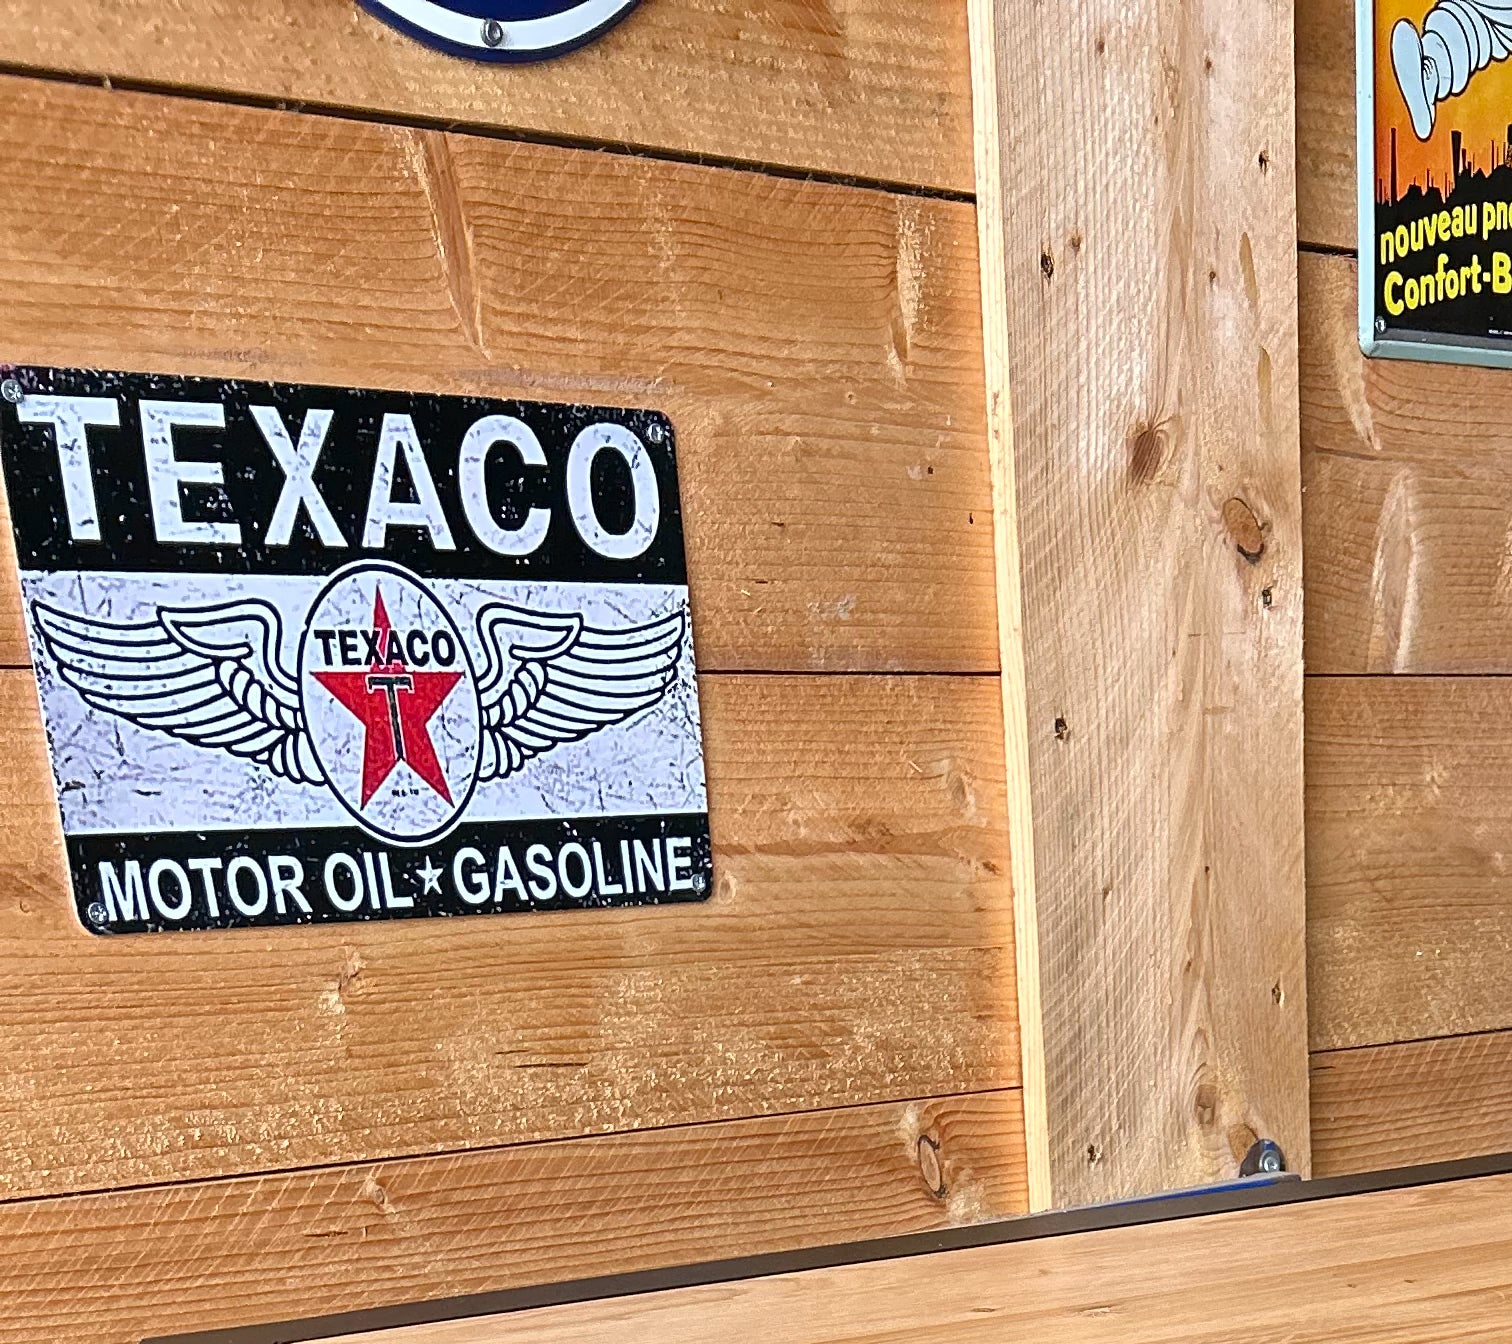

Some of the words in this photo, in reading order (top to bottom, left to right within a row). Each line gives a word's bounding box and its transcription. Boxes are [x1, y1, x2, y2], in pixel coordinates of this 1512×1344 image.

[1380, 203, 1477, 264] nouveau
[17, 396, 660, 560] TEXACO
[314, 629, 456, 667] TEXACO
[98, 858, 312, 923] MOTOR
[323, 849, 415, 911] OIL
[452, 836, 694, 903] GASOLINE
